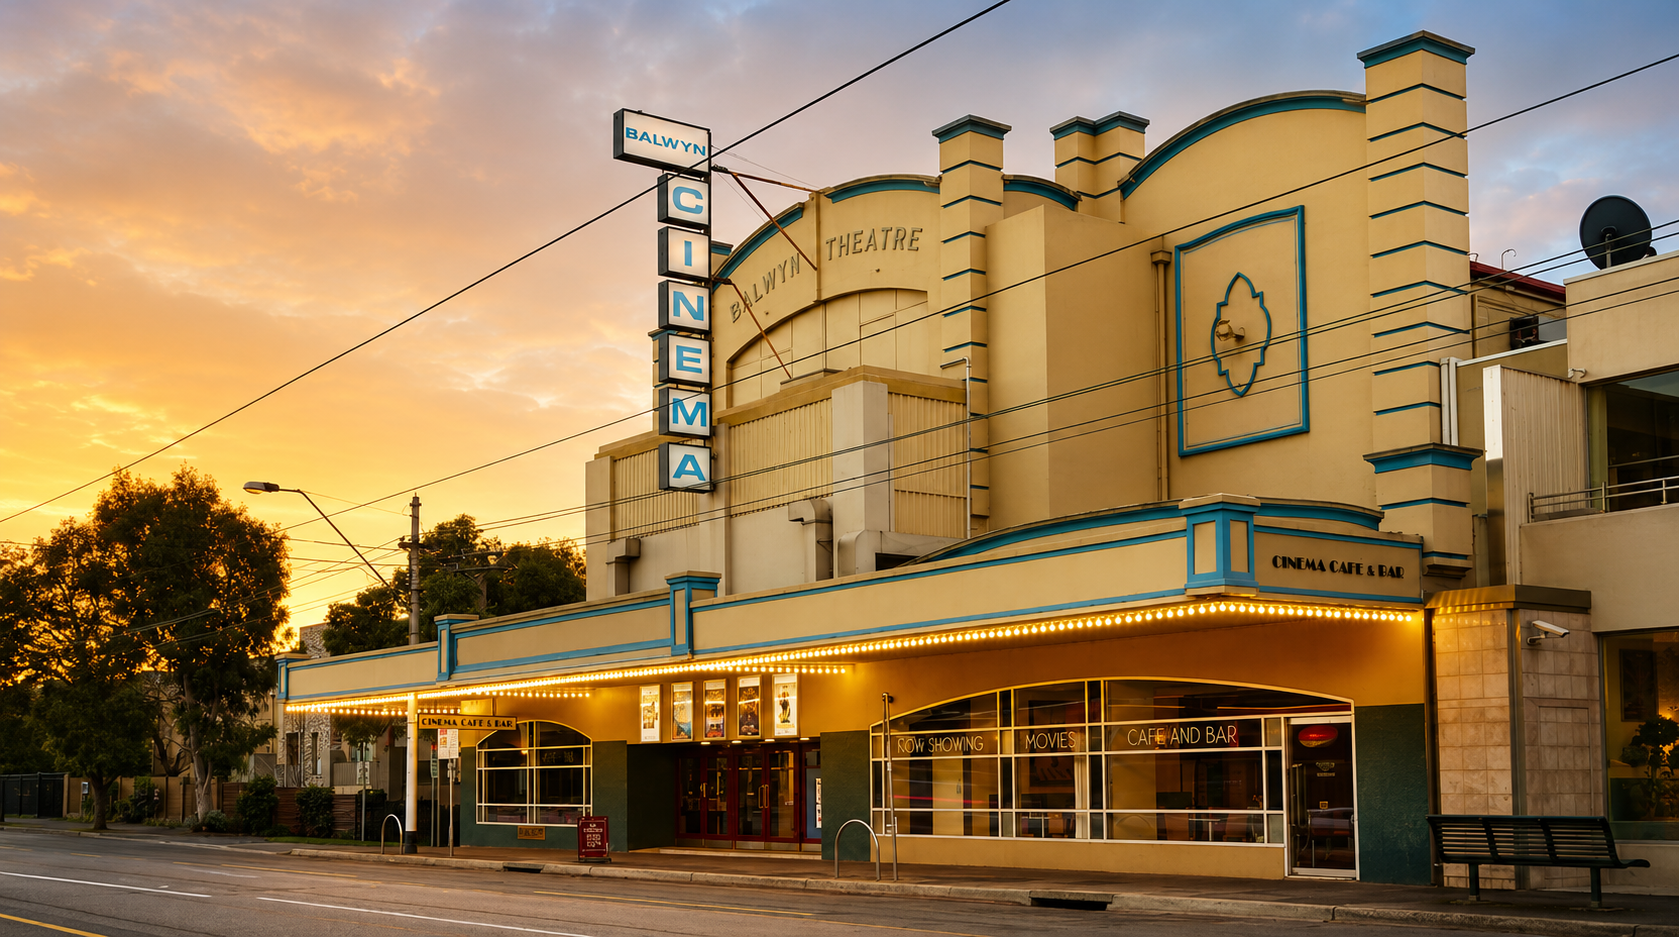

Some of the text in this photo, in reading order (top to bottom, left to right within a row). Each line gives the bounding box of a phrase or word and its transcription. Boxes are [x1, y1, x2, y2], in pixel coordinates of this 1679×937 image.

[625, 127, 706, 156] BALWYN
[730, 226, 923, 323] BALWYN THEATRE
[672, 186, 707, 481] CINEMA
[1272, 555, 1326, 572] CINEMA
[1366, 565, 1375, 577] &
[1378, 564, 1405, 579] BAR
[421, 717, 458, 727] CINEMA
[461, 718, 483, 727] CAFE
[495, 719, 513, 728] BAR
[928, 735, 984, 753] SHOWING
[1025, 731, 1077, 749] MOVIES
[1127, 725, 1238, 746] CAFE AND BAR
